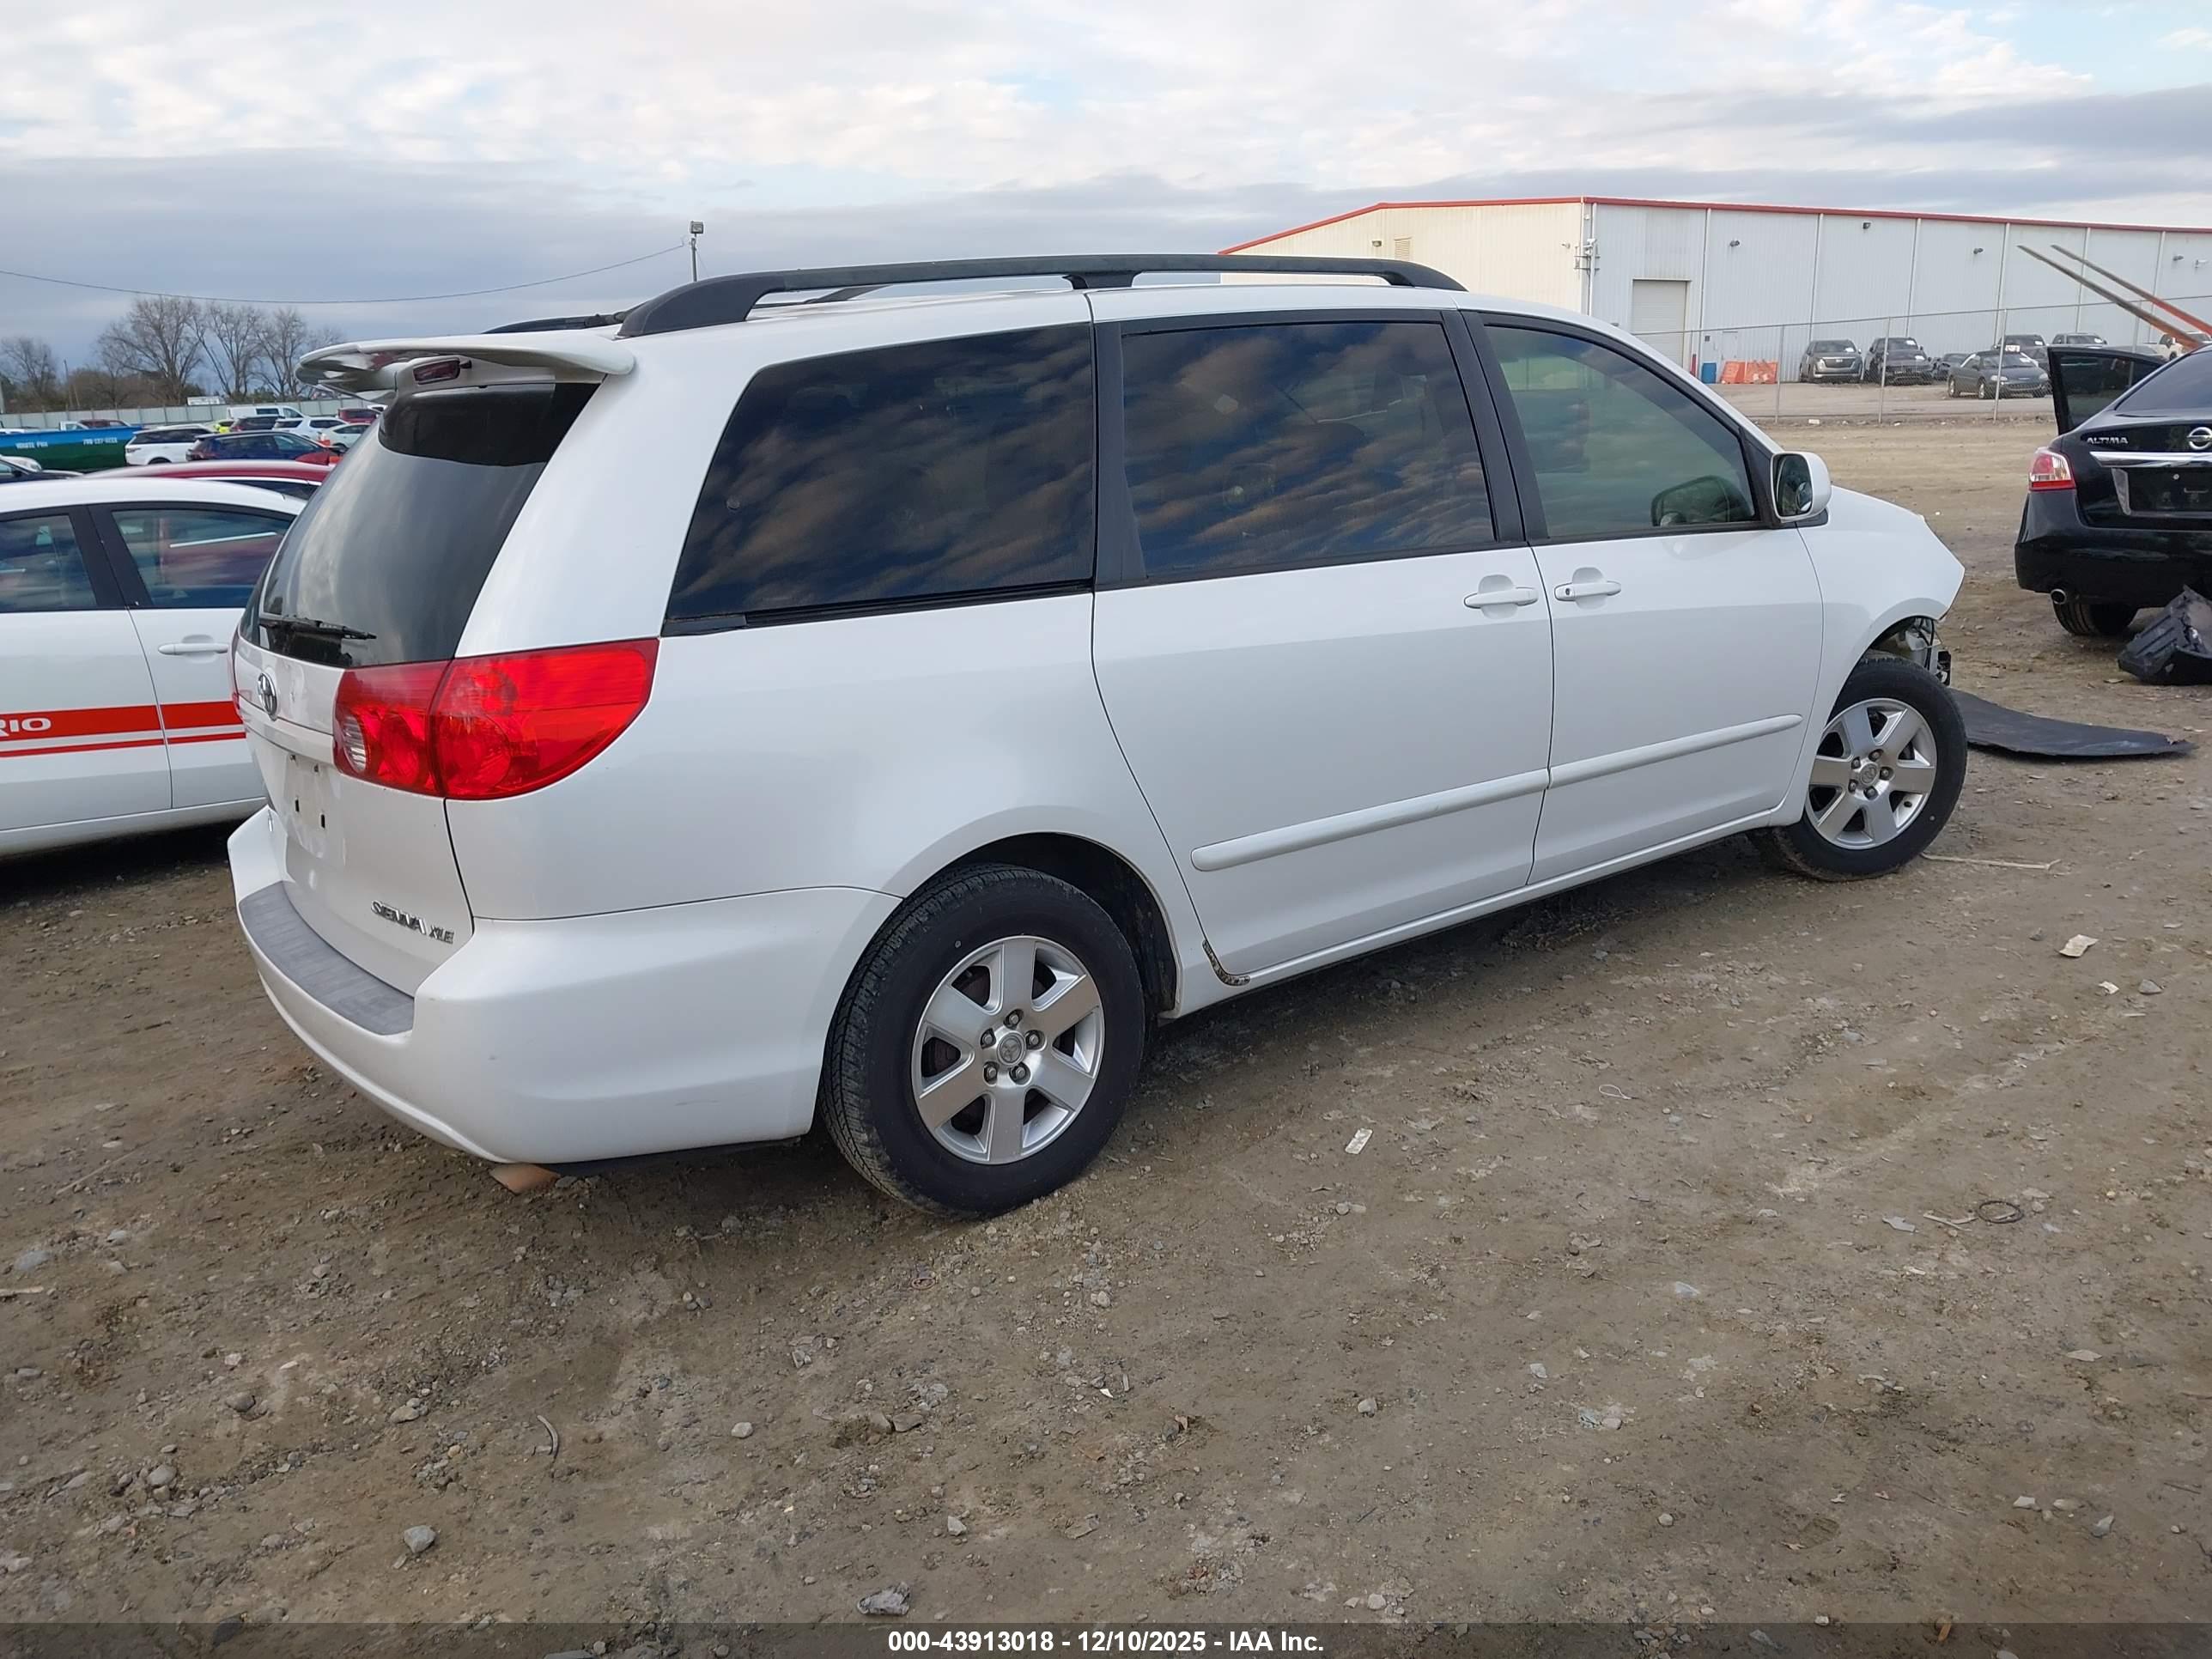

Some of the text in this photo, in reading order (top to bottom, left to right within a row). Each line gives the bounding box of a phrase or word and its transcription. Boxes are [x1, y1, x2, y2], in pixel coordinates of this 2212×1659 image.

[2087, 436, 2129, 445] ALTIMA
[371, 900, 454, 945] SIENNA XLE
